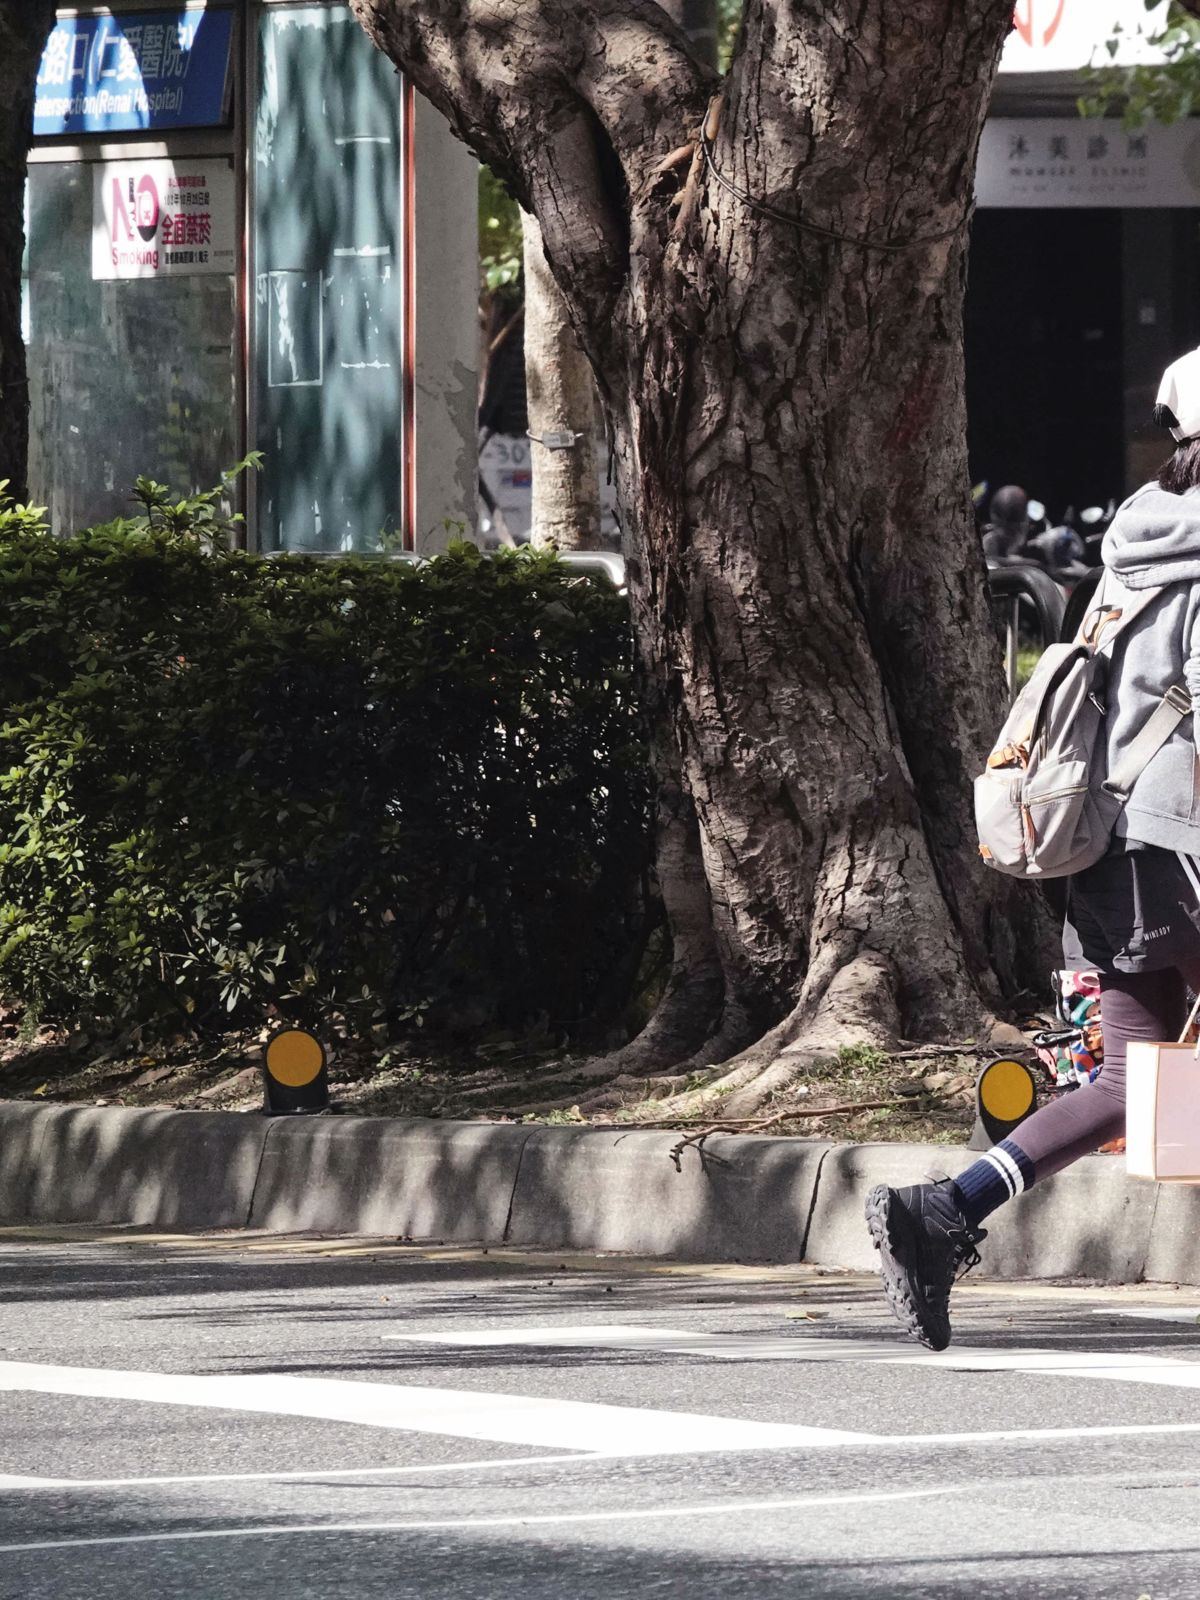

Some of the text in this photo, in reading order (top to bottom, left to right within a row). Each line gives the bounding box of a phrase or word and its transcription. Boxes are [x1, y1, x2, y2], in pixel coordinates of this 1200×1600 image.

[36, 24, 194, 85] 路口(仁愛醫院)
[112, 174, 160, 242] NO
[161, 212, 211, 245] 全面禁菸
[112, 247, 159, 270] Smoking
